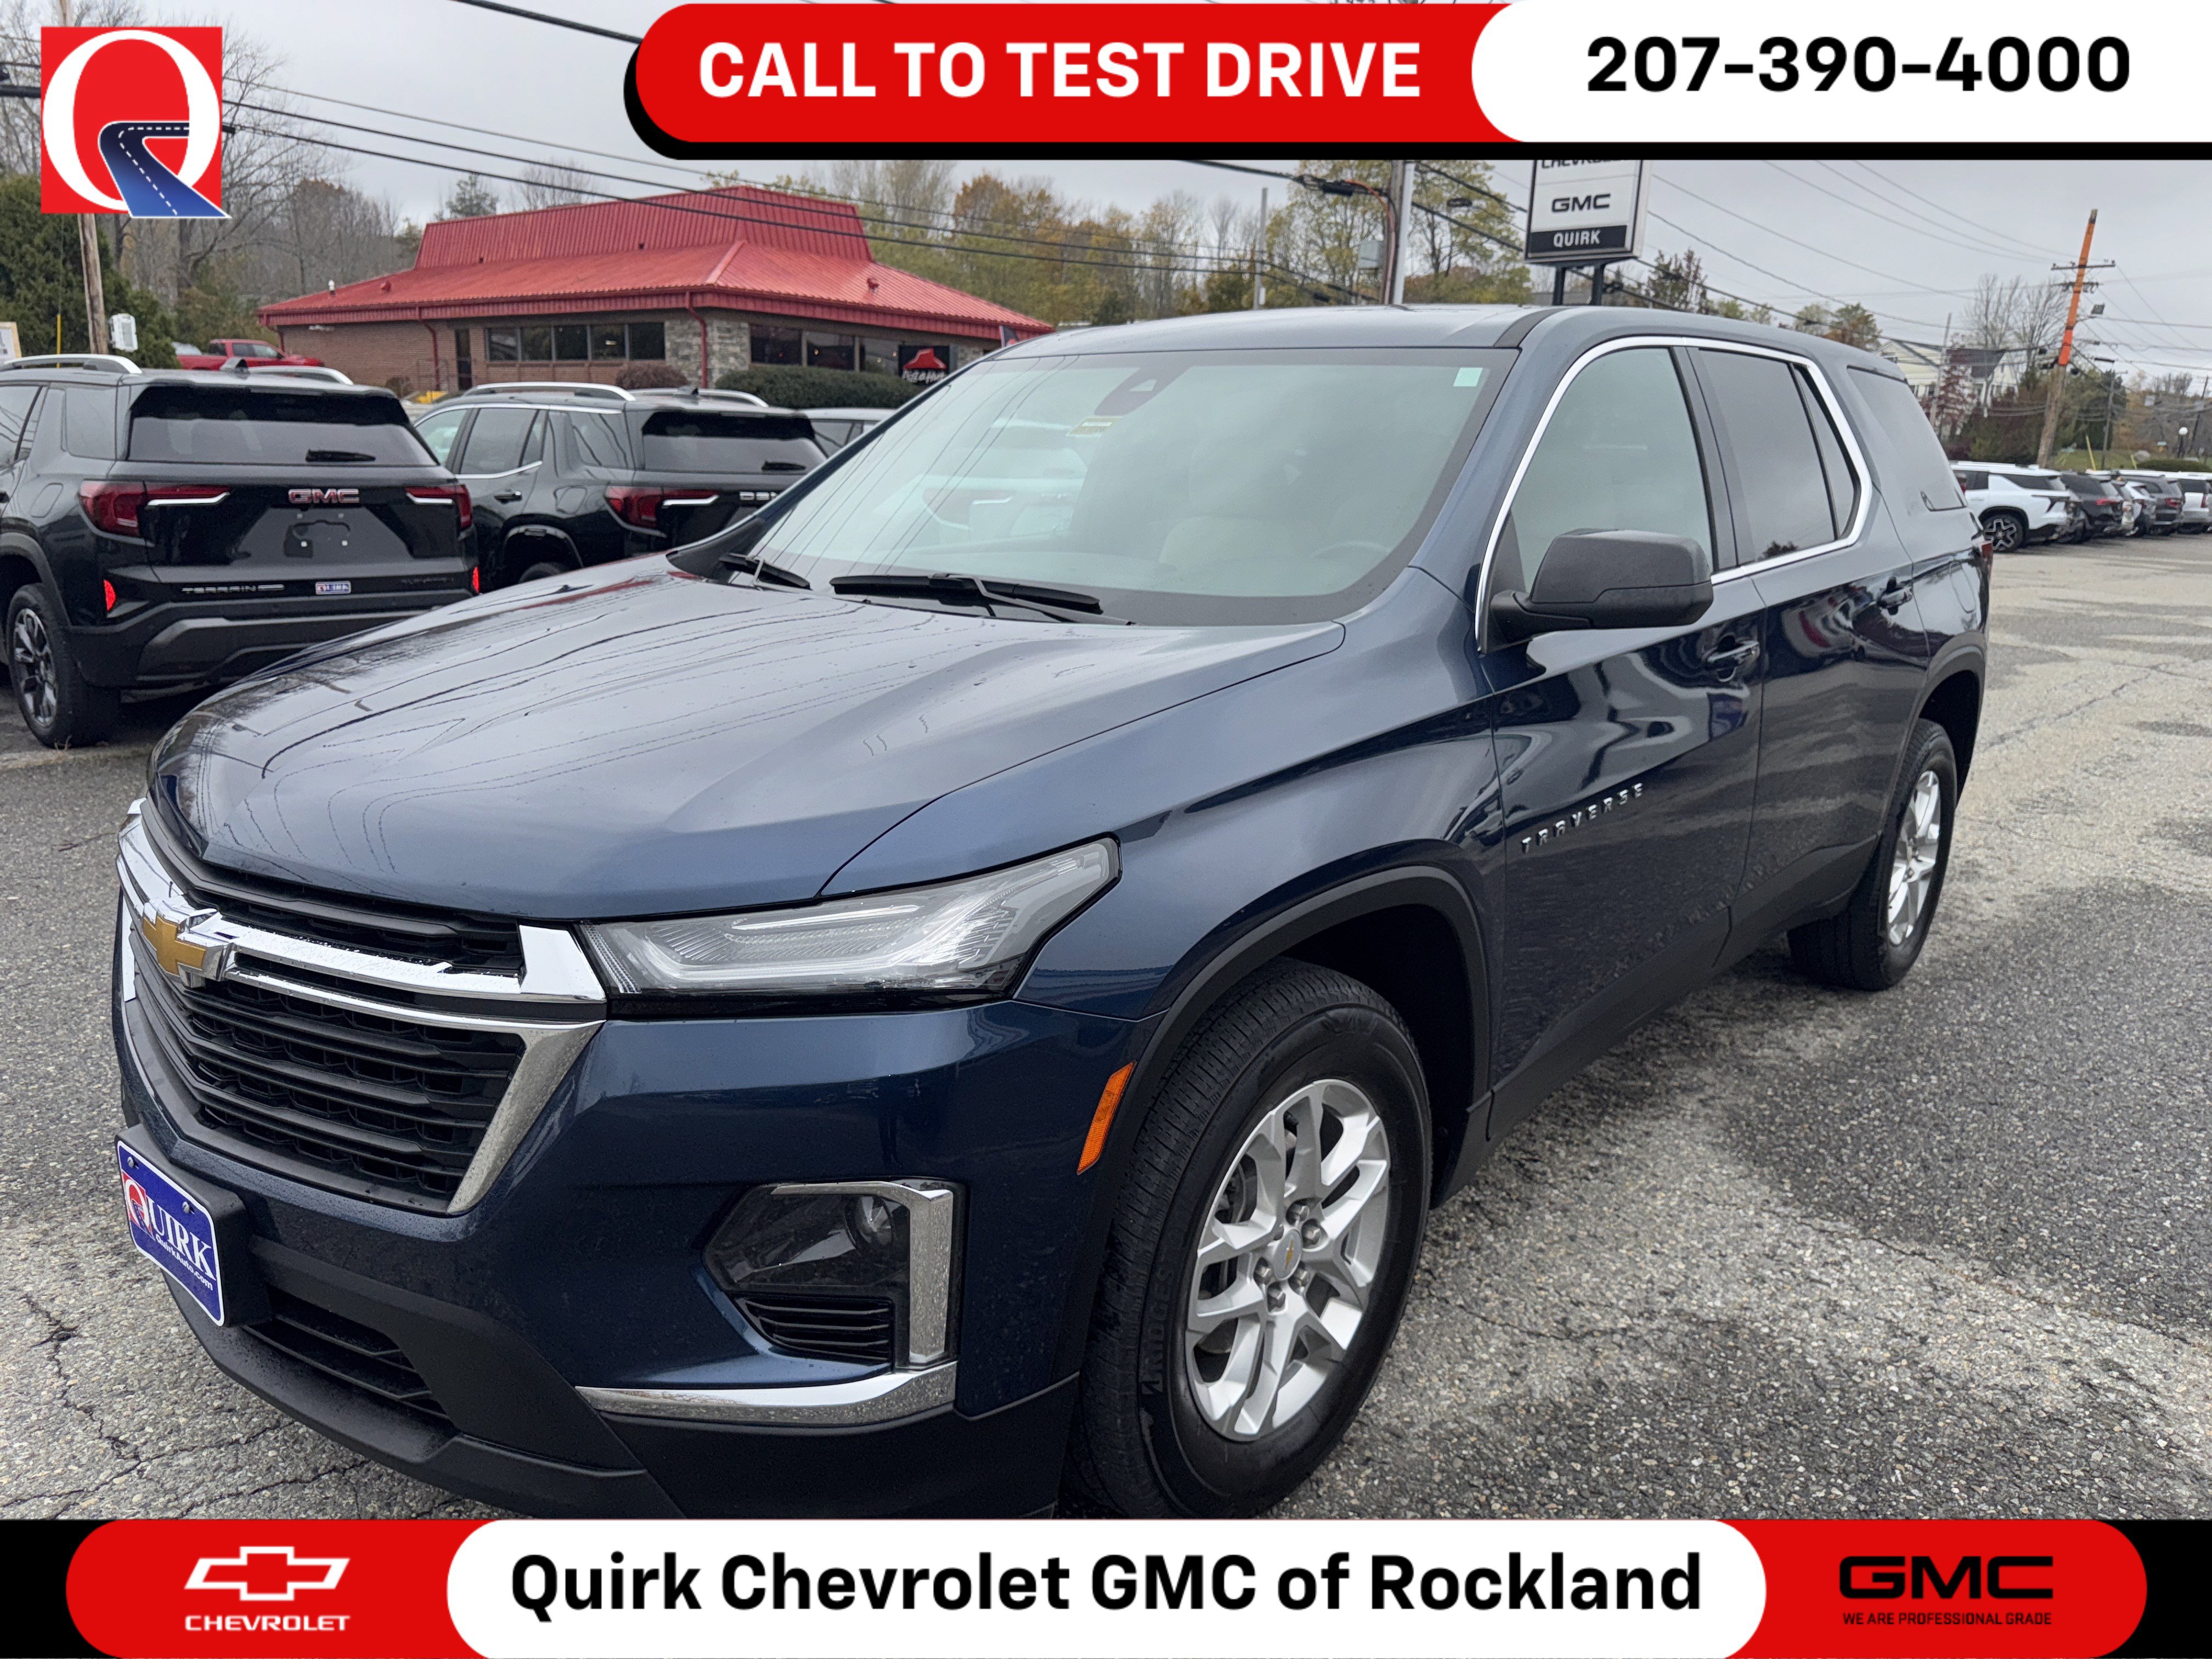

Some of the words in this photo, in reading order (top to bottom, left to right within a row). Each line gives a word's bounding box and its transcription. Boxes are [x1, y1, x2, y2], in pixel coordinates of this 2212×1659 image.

[1551, 194, 1611, 213] GMC
[1553, 229, 1601, 247] QUIRK
[288, 488, 360, 504] GMC
[1521, 782, 1643, 854] TRAVERSE
[125, 1178, 217, 1280] QUIRK
[155, 1234, 214, 1291] QuirkAuto.com
